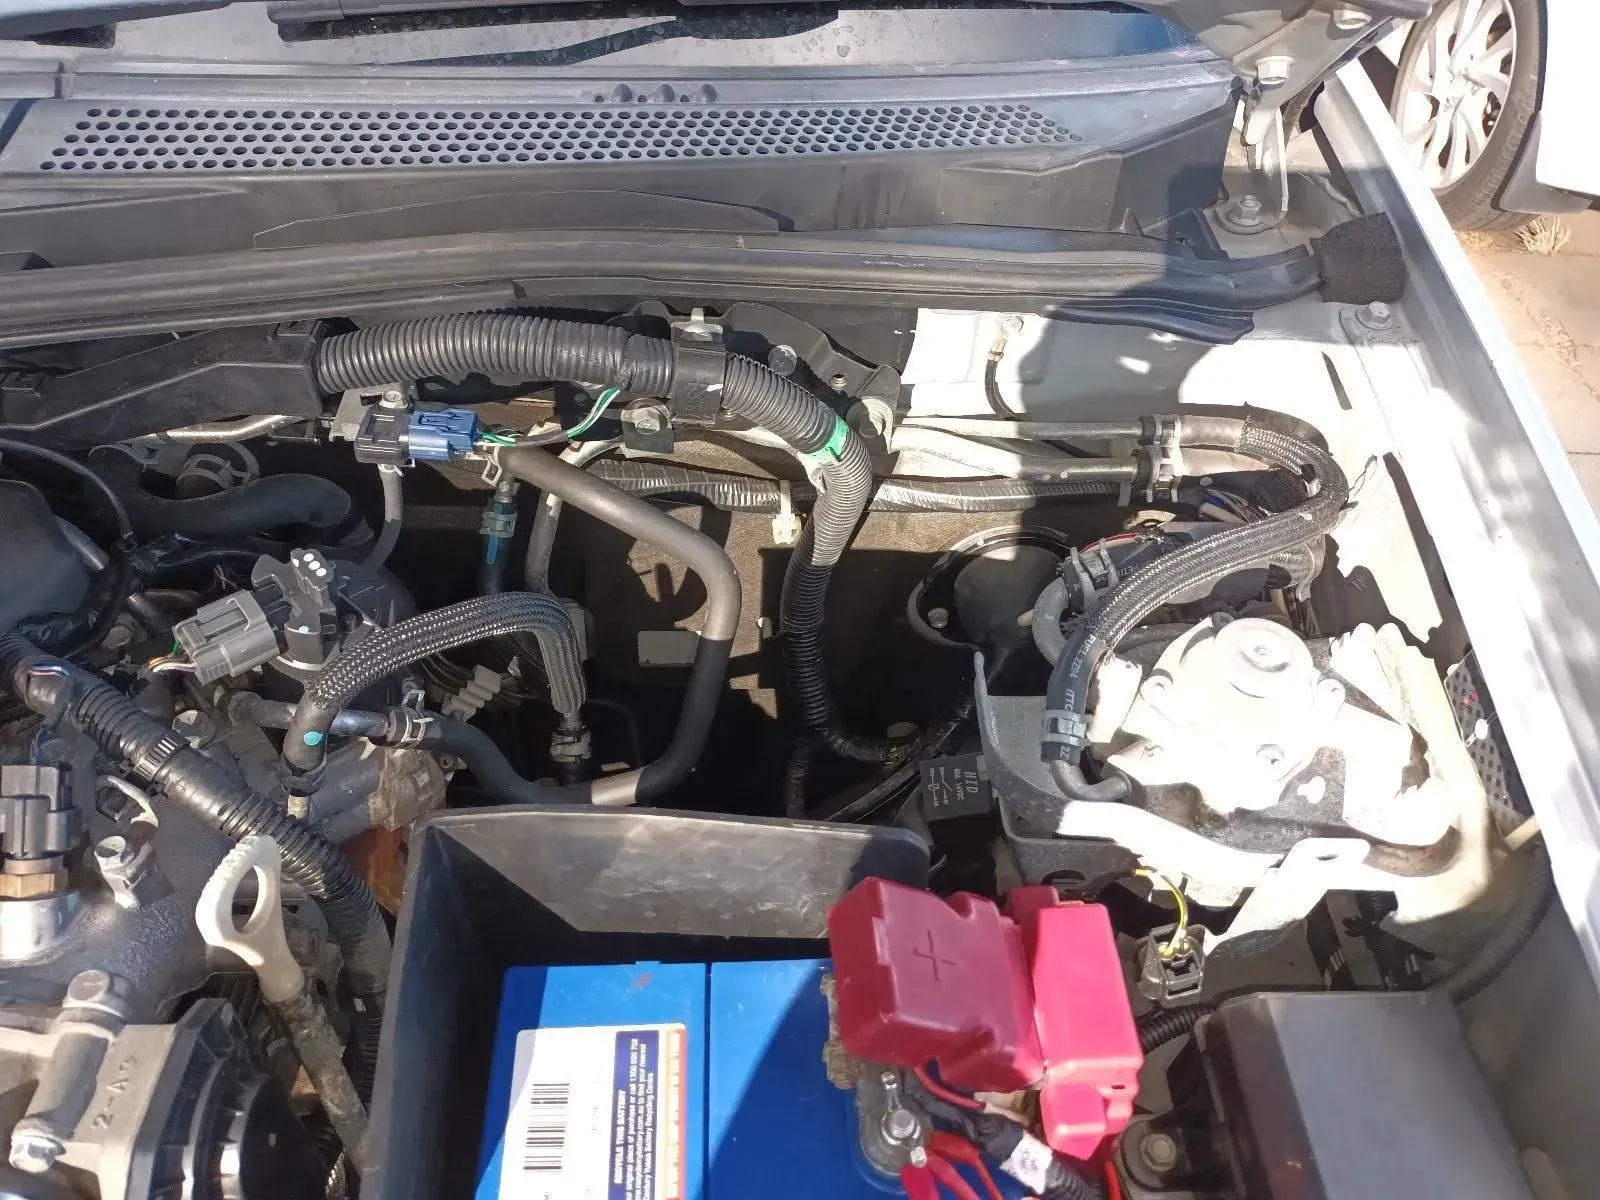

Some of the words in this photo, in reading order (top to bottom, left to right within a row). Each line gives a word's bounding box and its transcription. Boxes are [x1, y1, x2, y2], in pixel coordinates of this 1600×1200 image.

[1079, 633, 1097, 656] FUEL
[964, 771, 978, 793] HID
[617, 1089, 626, 1125] BATTERY
[628, 1103, 636, 1135] purchase
[616, 1126, 625, 1145] THIS
[614, 1146, 624, 1184] RECYCLE
